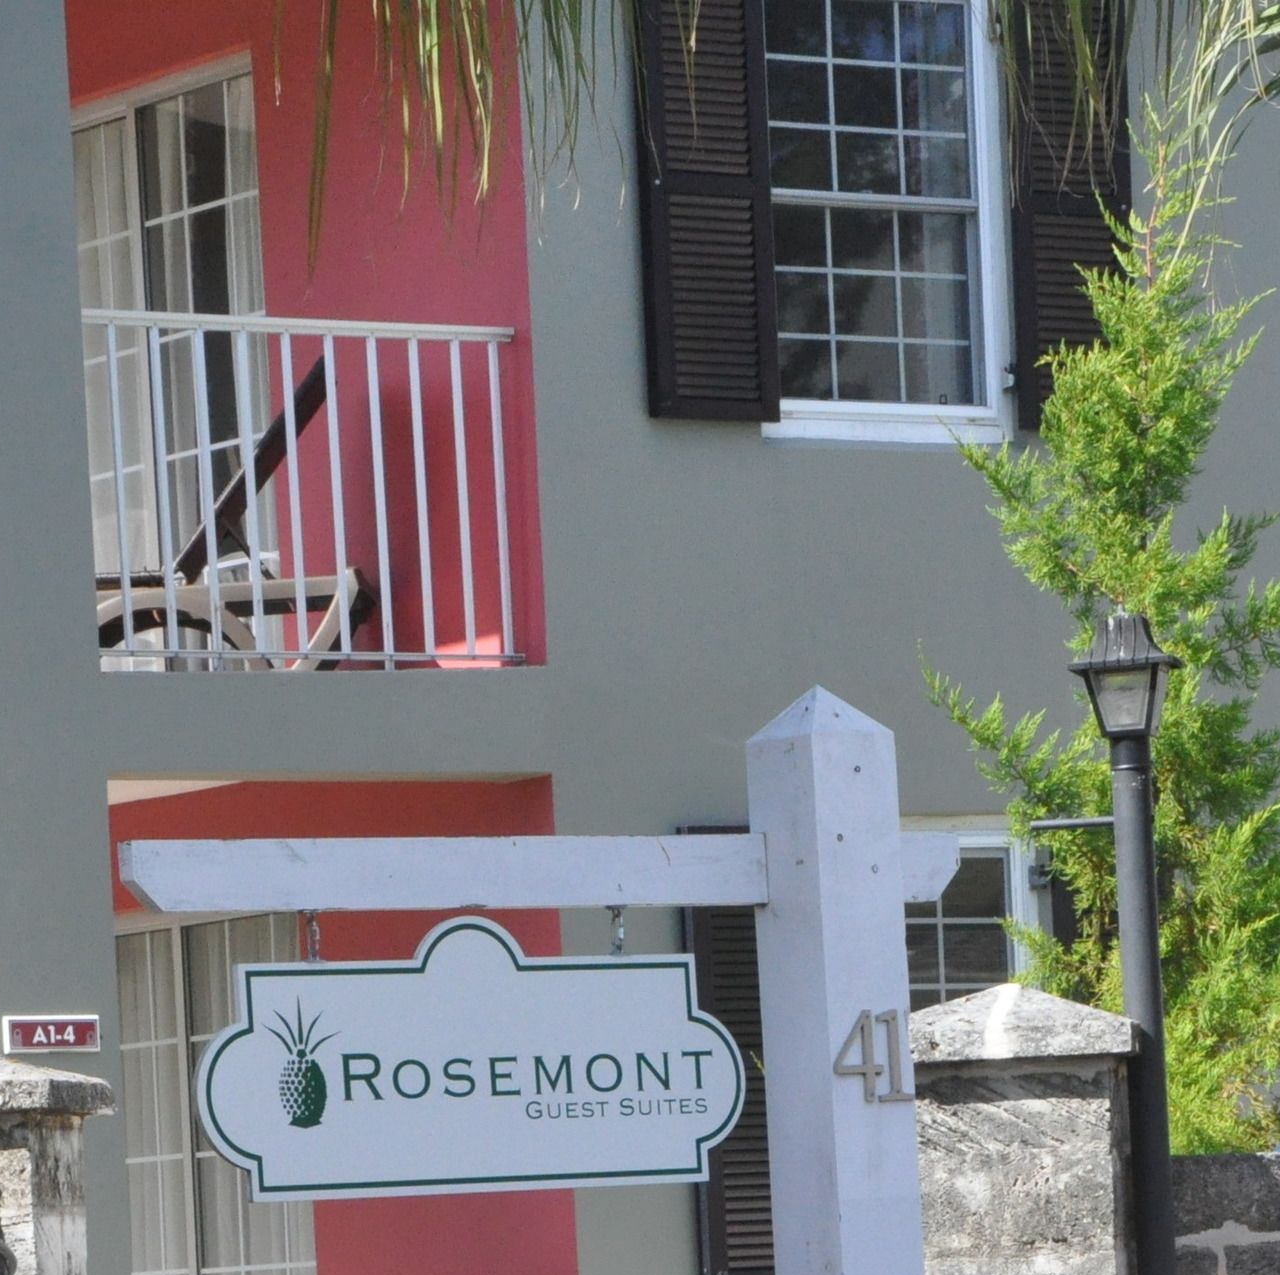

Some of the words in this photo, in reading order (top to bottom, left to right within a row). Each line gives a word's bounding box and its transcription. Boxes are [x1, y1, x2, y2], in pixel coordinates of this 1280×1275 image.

[32, 1024, 76, 1045] A1-4
[833, 1009, 914, 1103] 41
[340, 1049, 713, 1101] ROSEMONT
[525, 1101, 610, 1120] GUEST
[620, 1097, 708, 1117] SUITES
